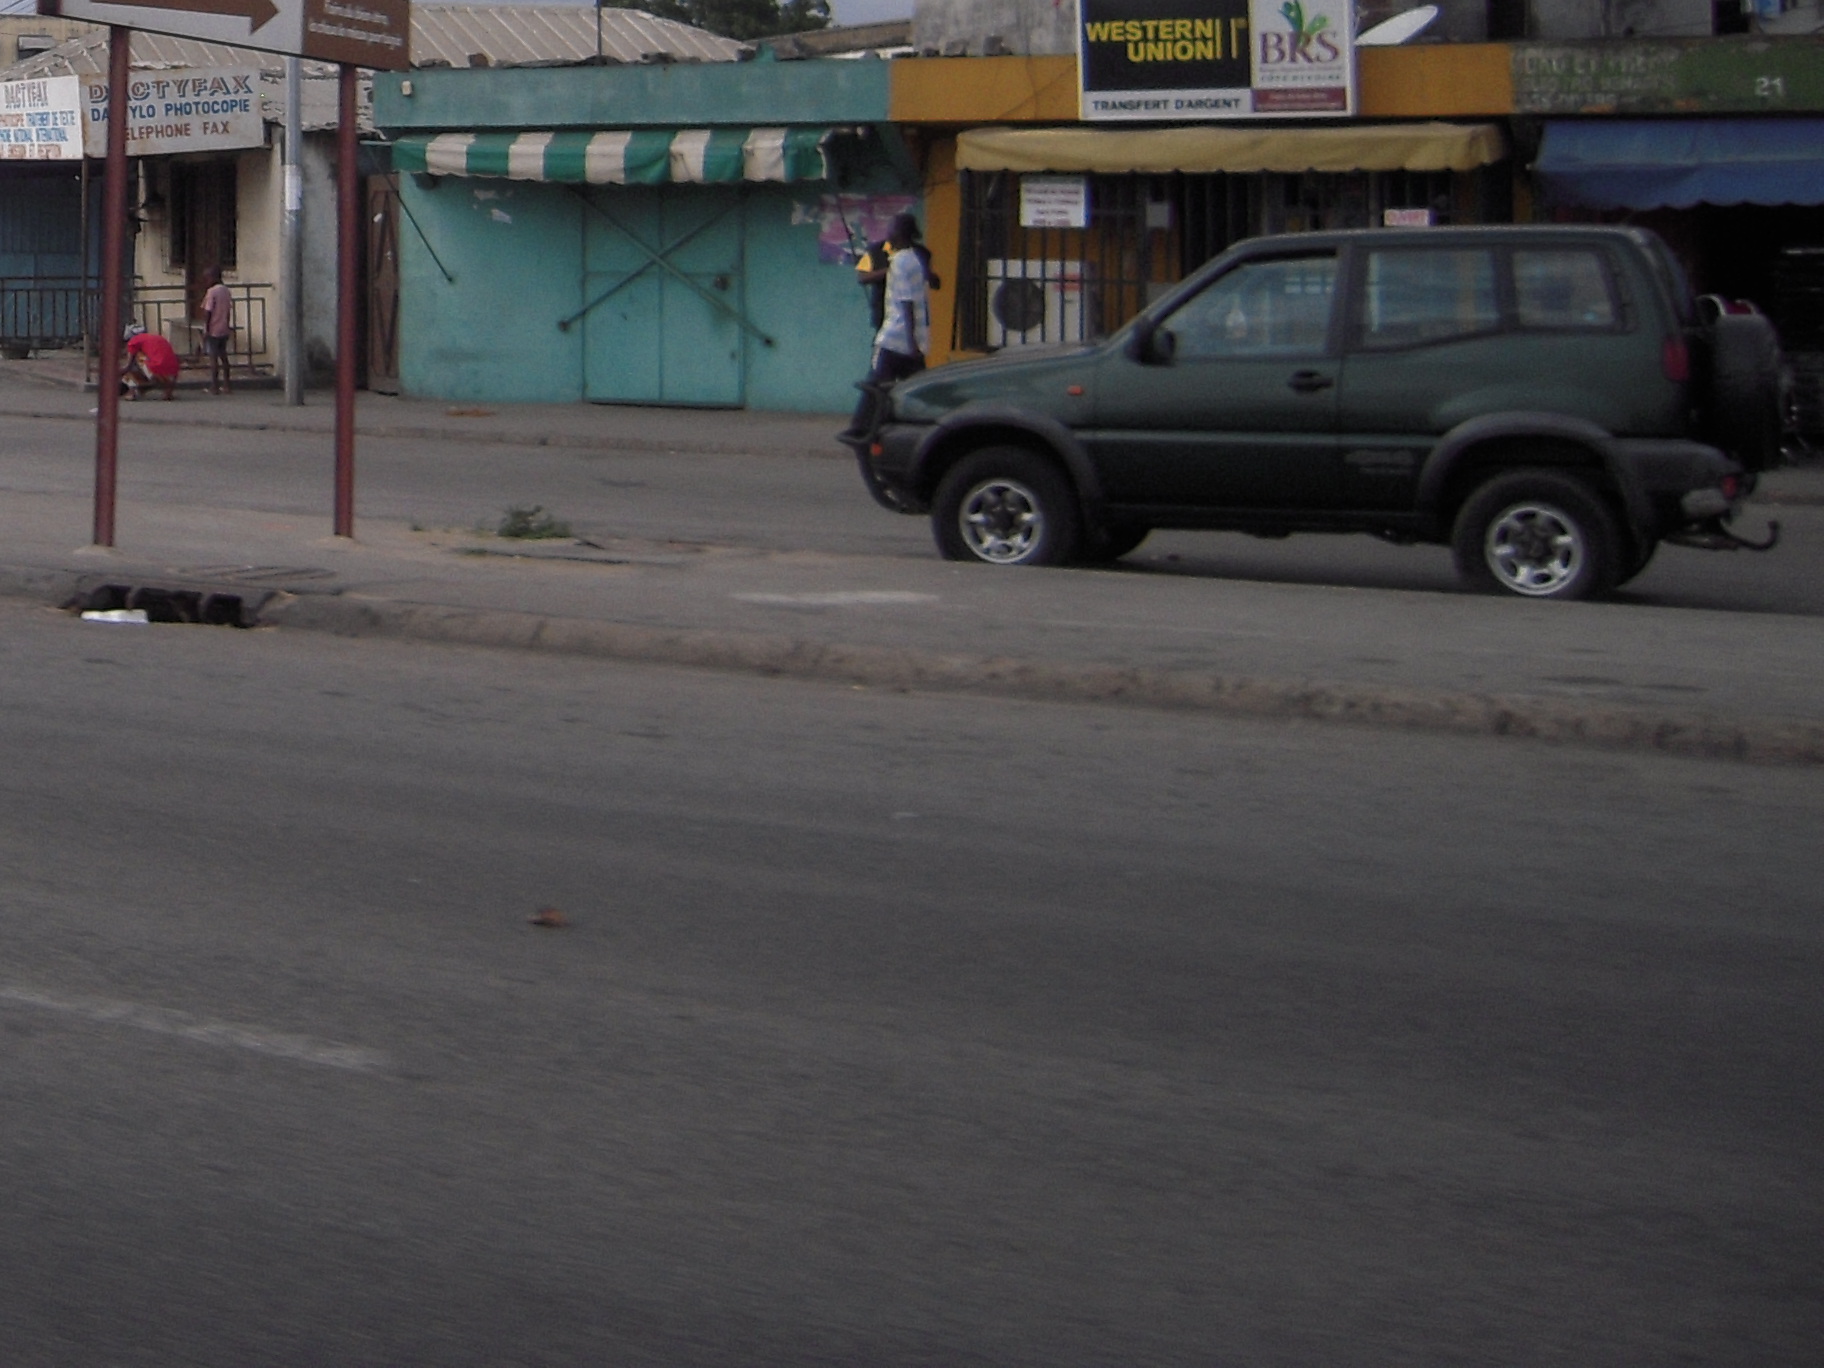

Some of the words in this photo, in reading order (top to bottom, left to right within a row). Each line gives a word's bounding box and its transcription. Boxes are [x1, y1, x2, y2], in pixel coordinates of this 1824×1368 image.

[1085, 18, 1213, 42] WESTERN
[1127, 40, 1213, 62] UNION
[1259, 31, 1339, 64] BRS
[89, 75, 254, 104] DCTYFAX
[1754, 77, 1783, 97] 21
[91, 103, 156, 122] DAYLO
[164, 99, 250, 117] PHOTOCOPIE
[1092, 99, 1169, 112] TRANSFERT
[1174, 97, 1241, 111] D'ARGENT
[126, 122, 191, 141] ELEPHONE
[203, 120, 230, 136] FAX
